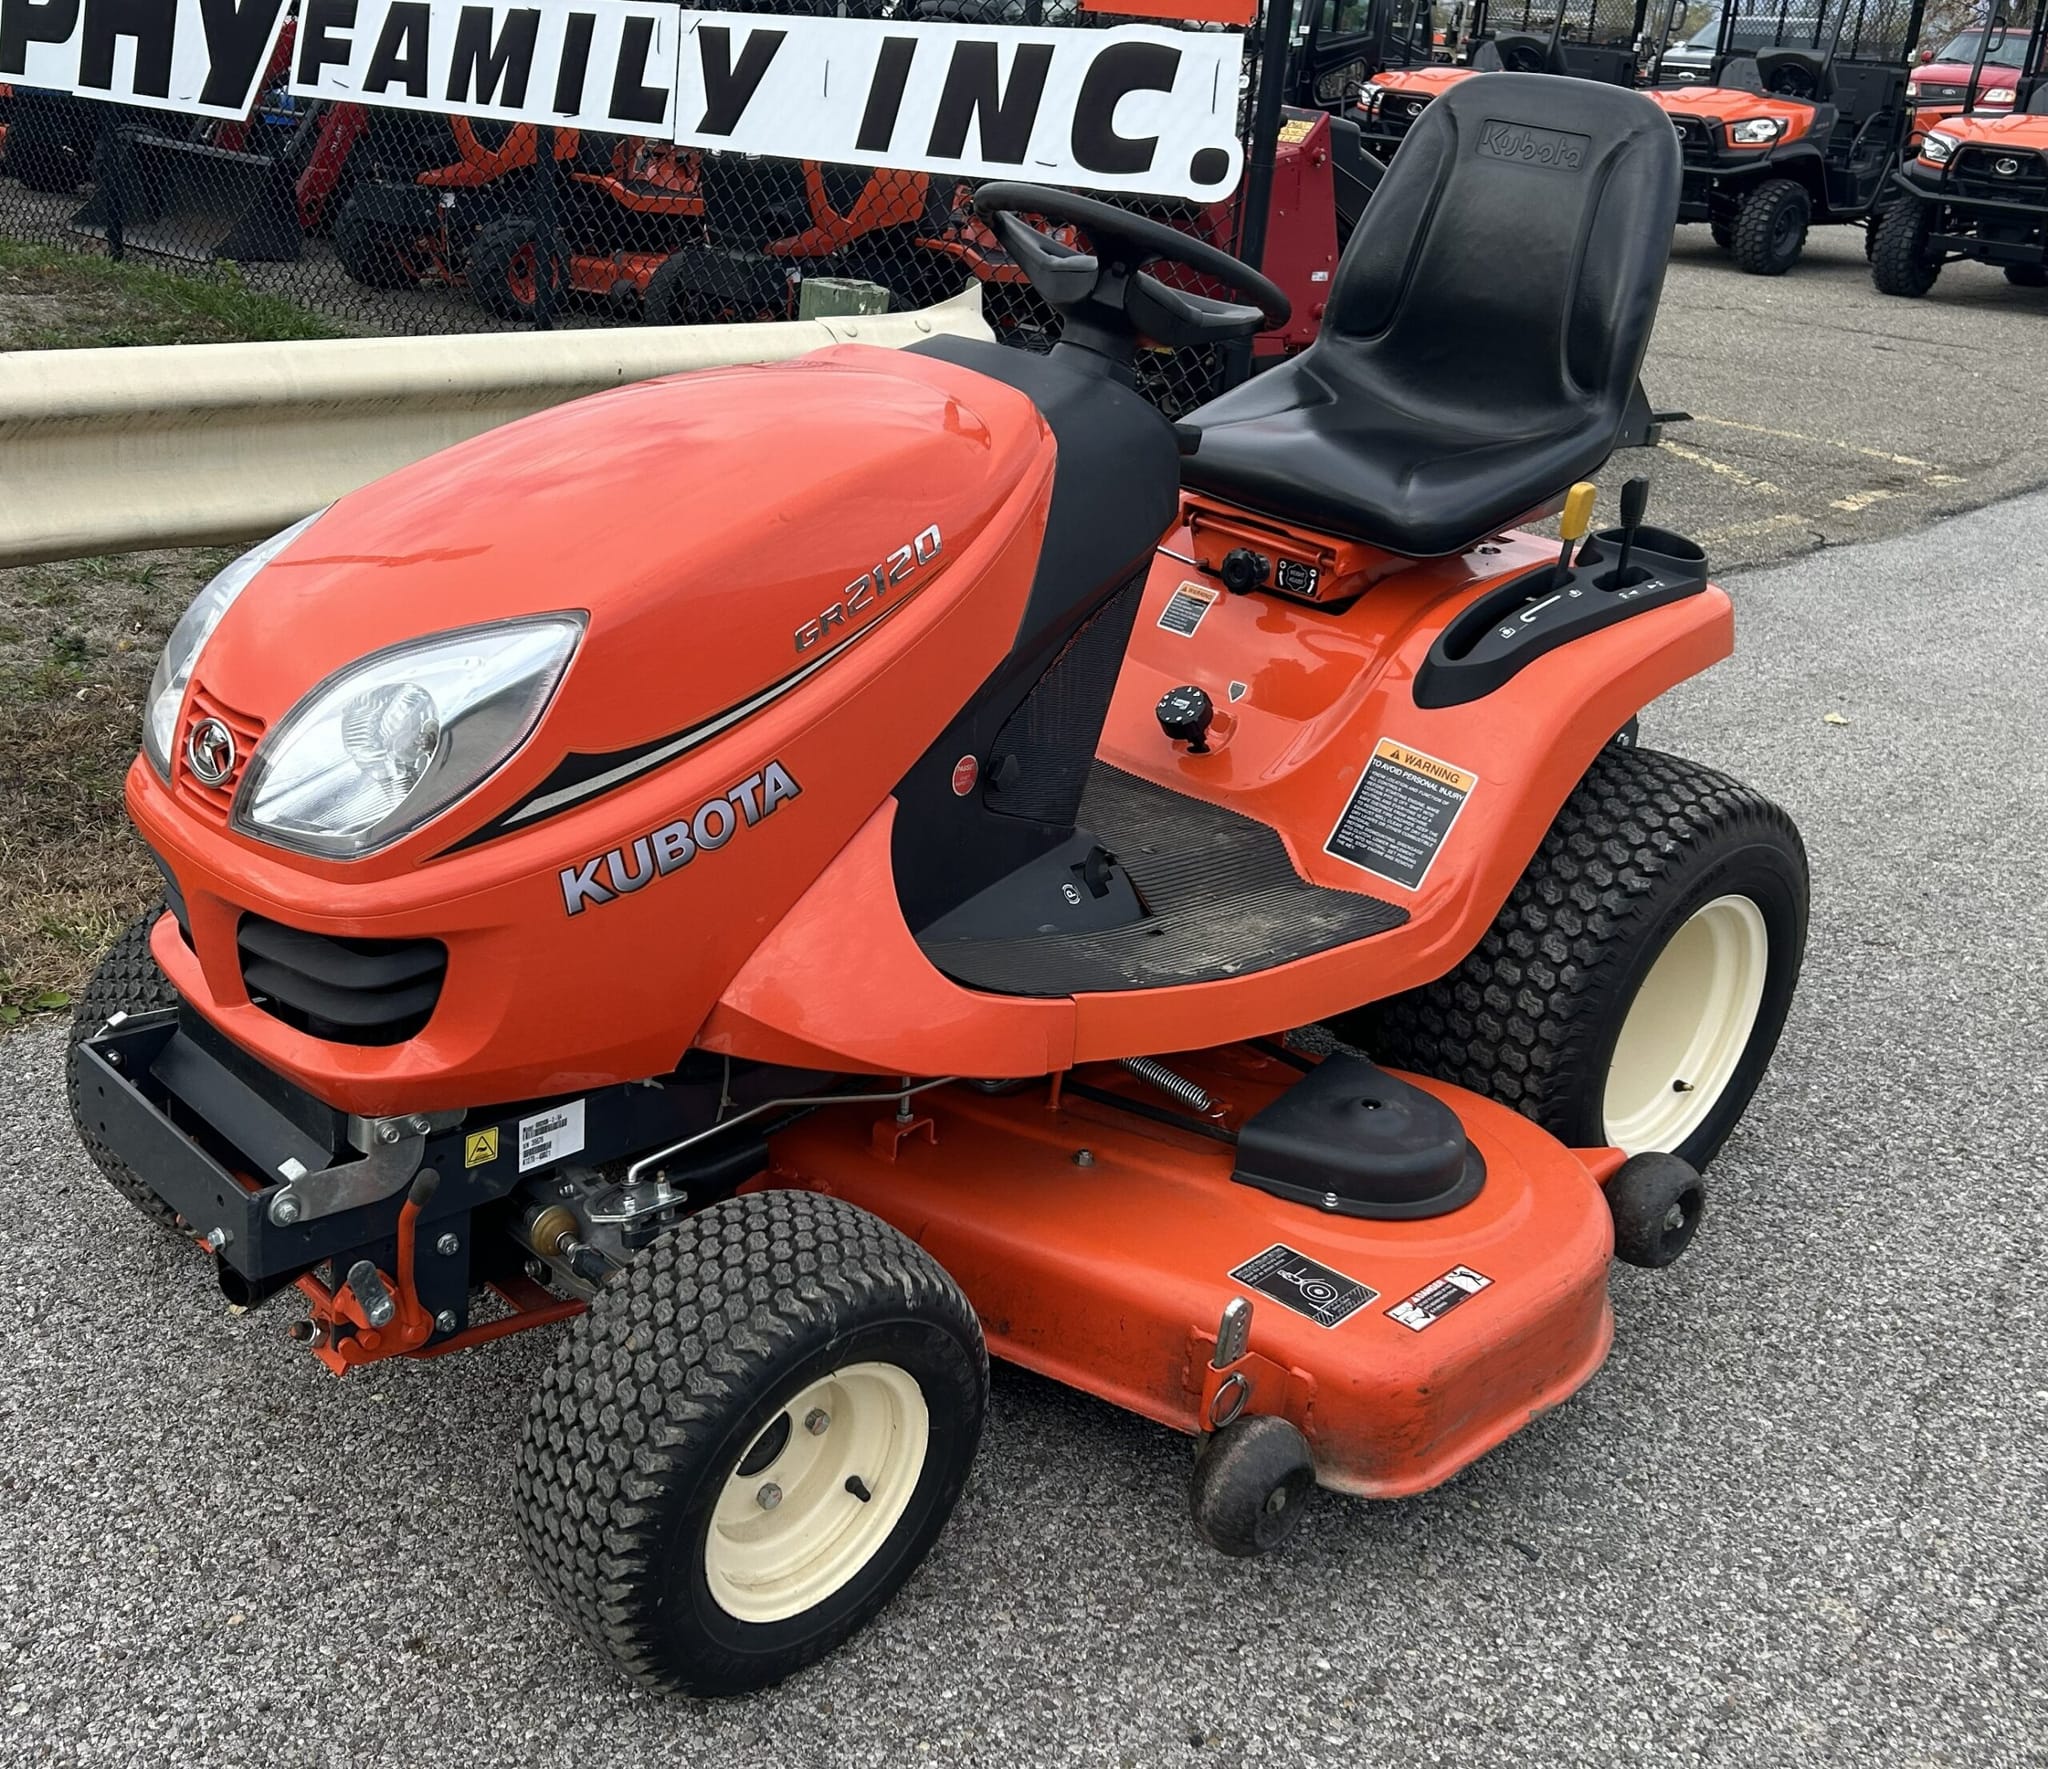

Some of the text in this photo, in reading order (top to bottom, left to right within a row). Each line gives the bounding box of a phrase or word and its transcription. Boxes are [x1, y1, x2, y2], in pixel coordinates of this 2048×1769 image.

[296, 0, 788, 136] FAMILY
[855, 36, 1230, 187] INC.
[1481, 126, 1580, 168] Kubota
[794, 524, 943, 653] GR2120
[1371, 759, 1382, 767] TO
[1381, 762, 1402, 775] AVOID
[1402, 771, 1439, 791] PERSONAL
[1403, 752, 1461, 785] WARNING
[560, 760, 802, 917] KUBOTA
